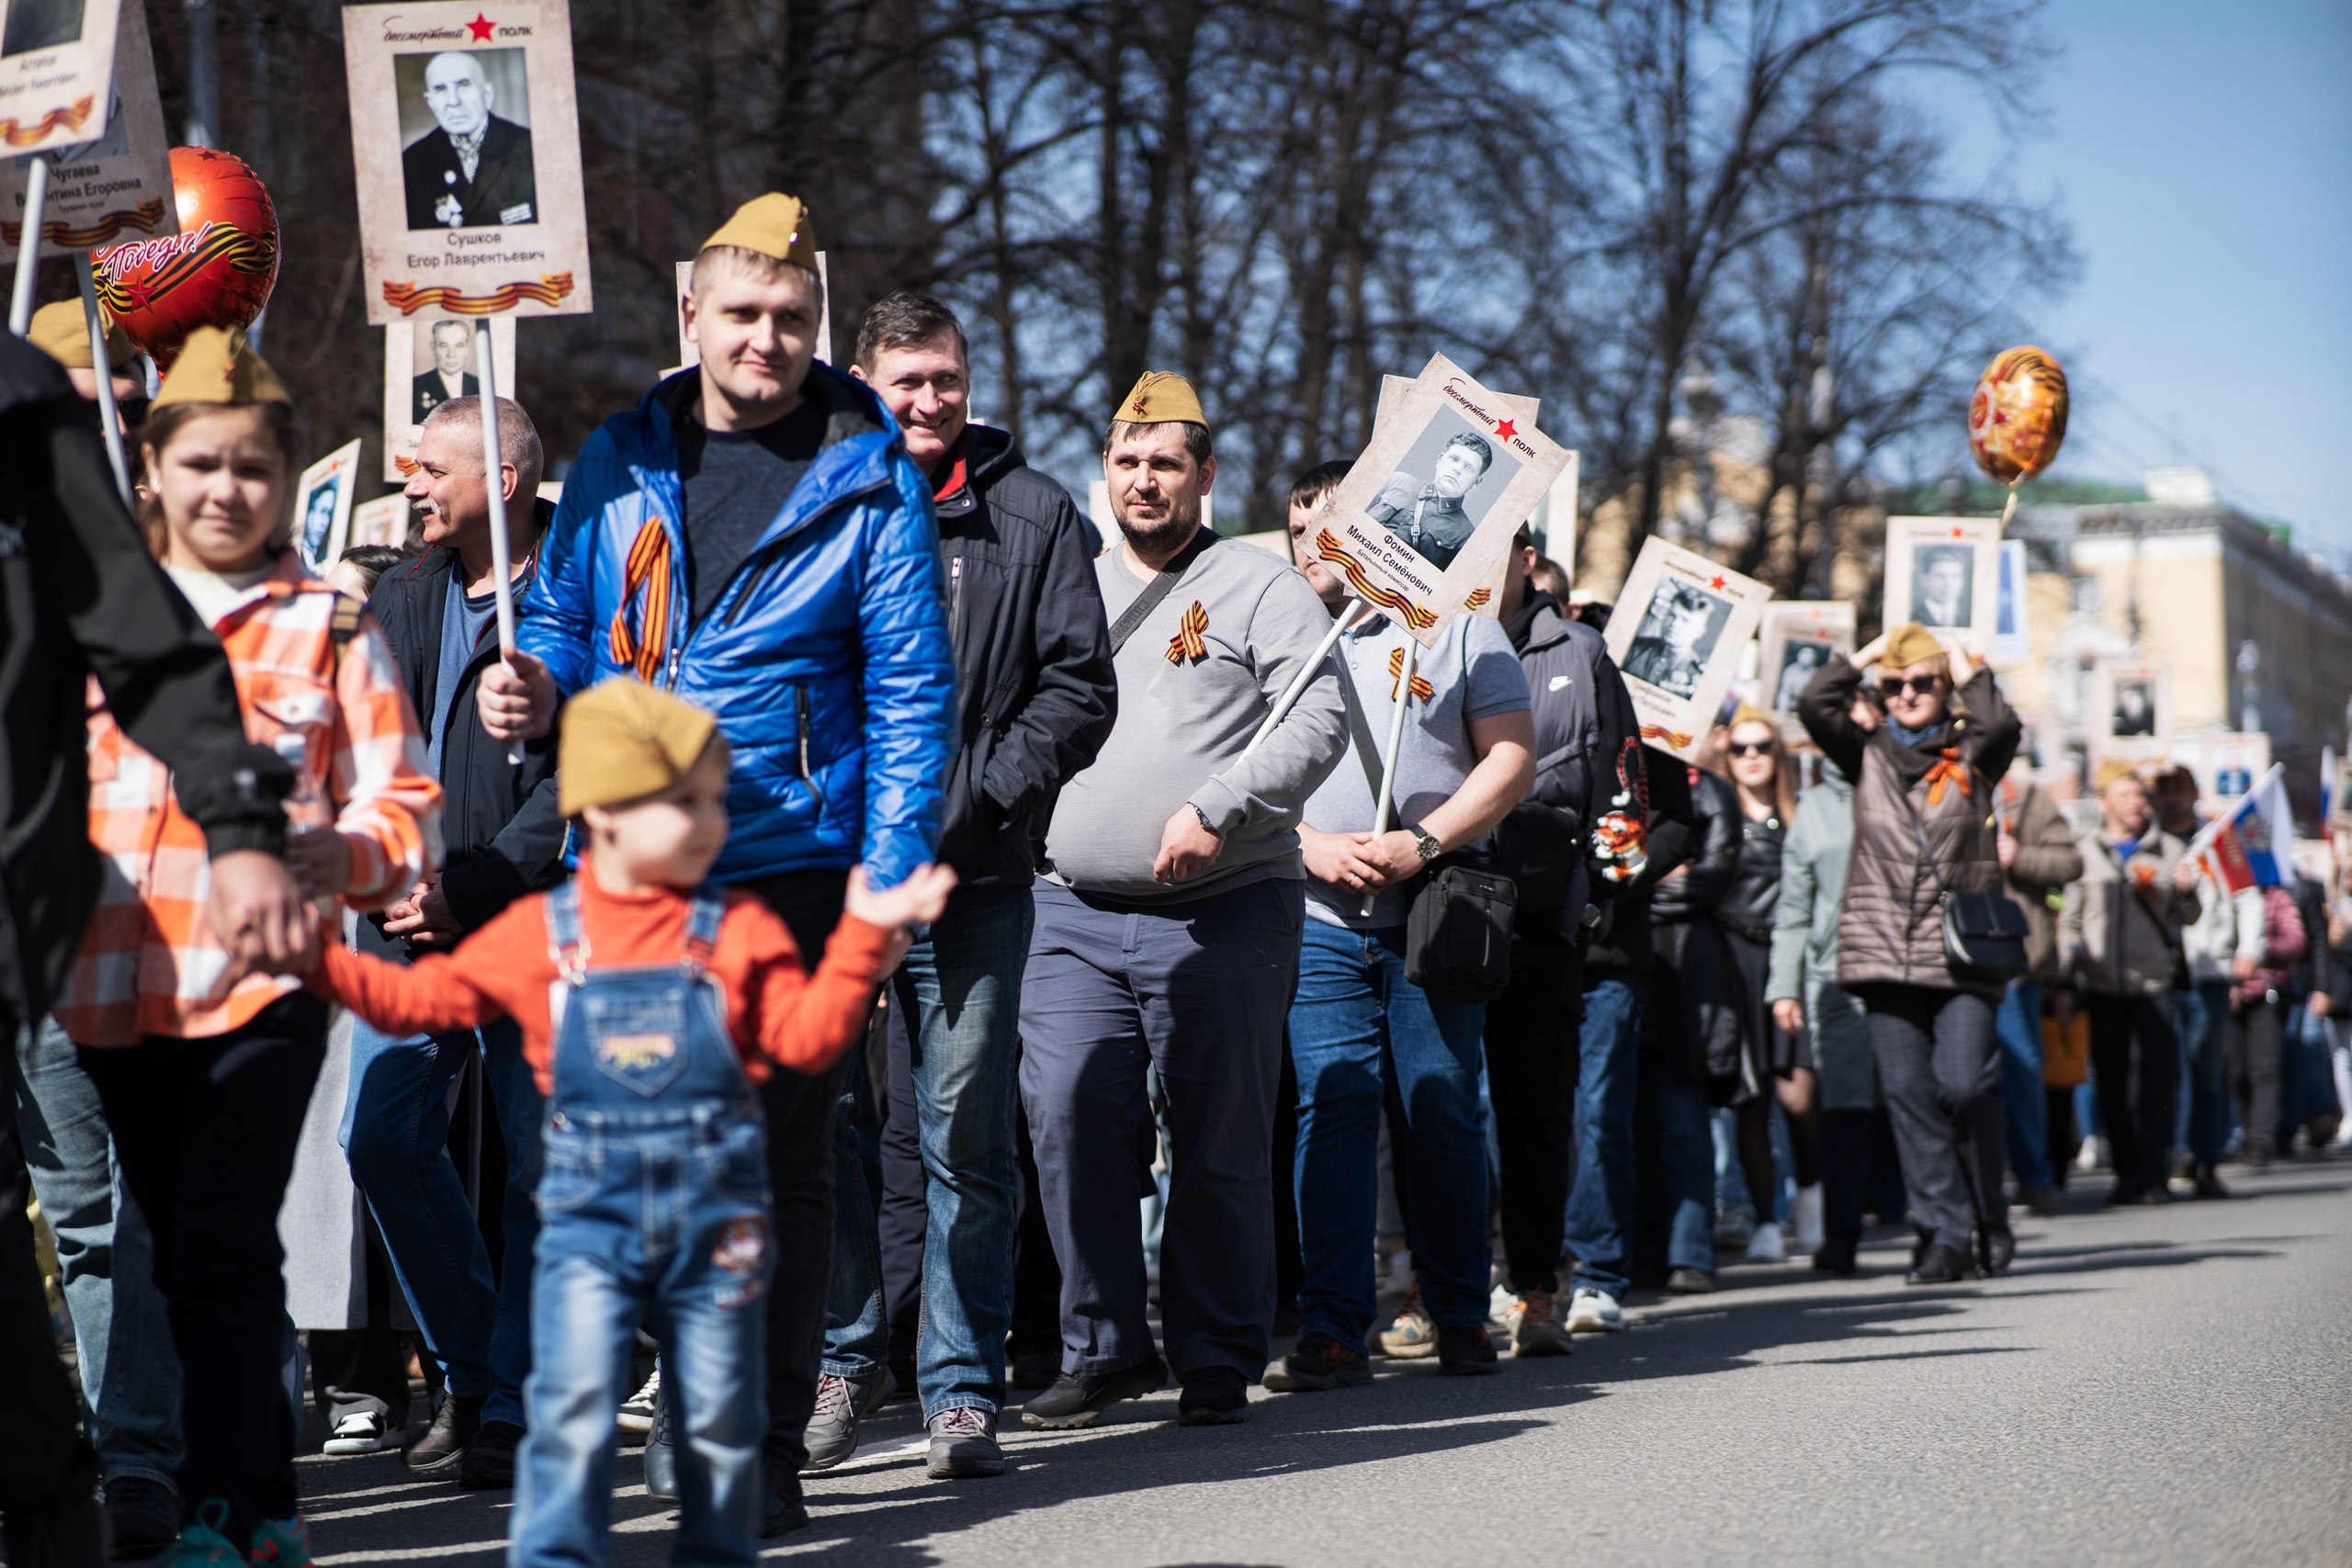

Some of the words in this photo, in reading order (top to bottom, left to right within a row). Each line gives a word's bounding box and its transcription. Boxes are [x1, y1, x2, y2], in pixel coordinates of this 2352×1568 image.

[50, 164, 100, 184] Чугаева
[15, 186, 82, 207] Внтина
[85, 178, 141, 197] Егоровна
[101, 220, 213, 287] Победы!
[447, 231, 502, 249] Сушков
[407, 254, 440, 269] Егор
[445, 251, 546, 268] Лаврентьевич
[1442, 377, 1497, 426] бессмертный
[1346, 525, 1383, 558] Михаил
[1382, 552, 1433, 596] Семёнович
[1384, 535, 1416, 563] Фомин
[1356, 548, 1388, 575] Батальонный
[1387, 573, 1409, 592] комиссар
